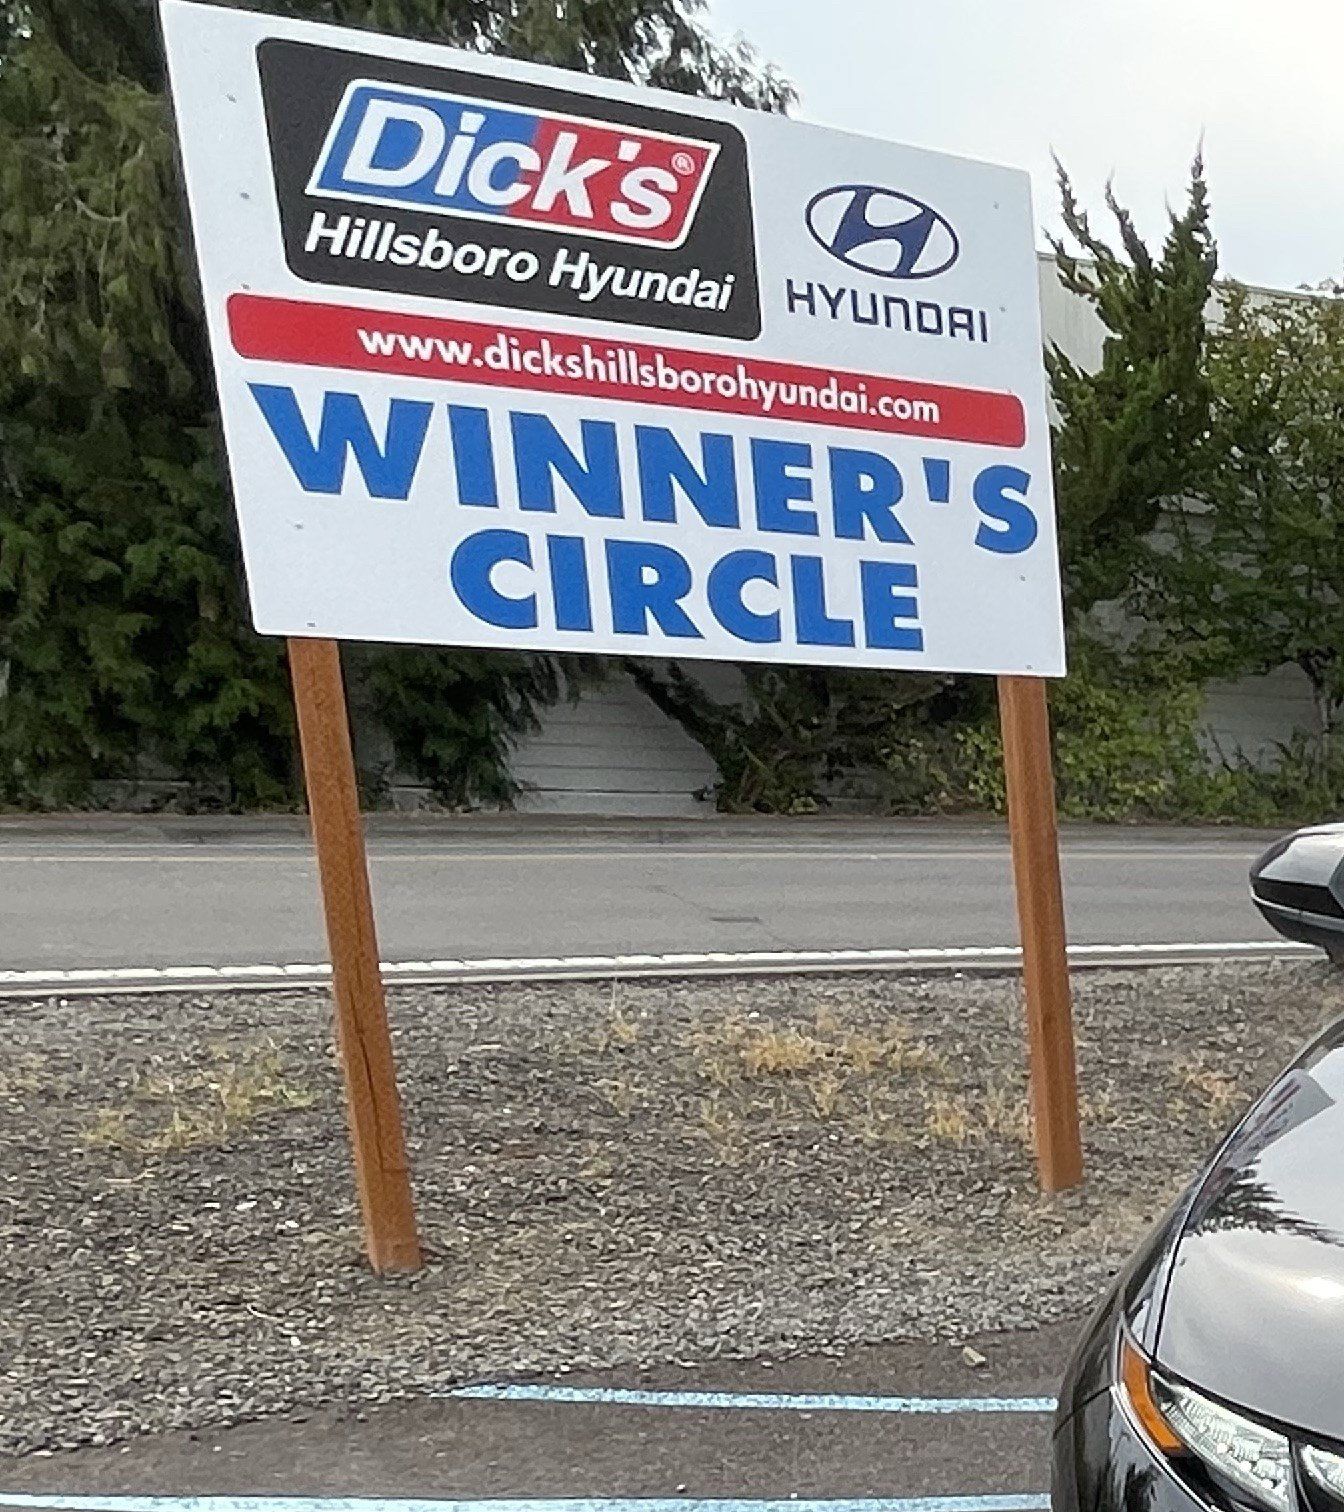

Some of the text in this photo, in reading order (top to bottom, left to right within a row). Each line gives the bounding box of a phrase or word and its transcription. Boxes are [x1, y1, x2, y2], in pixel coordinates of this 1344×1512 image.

[342, 98, 679, 229] Dick's
[304, 211, 736, 312] Hillsboro Hyundai
[785, 278, 989, 343] HYUNDAI
[357, 327, 941, 424] www.dickshillsborohyundai.com
[246, 381, 1040, 556] WINNER'S
[449, 527, 925, 653] CIRCLE
